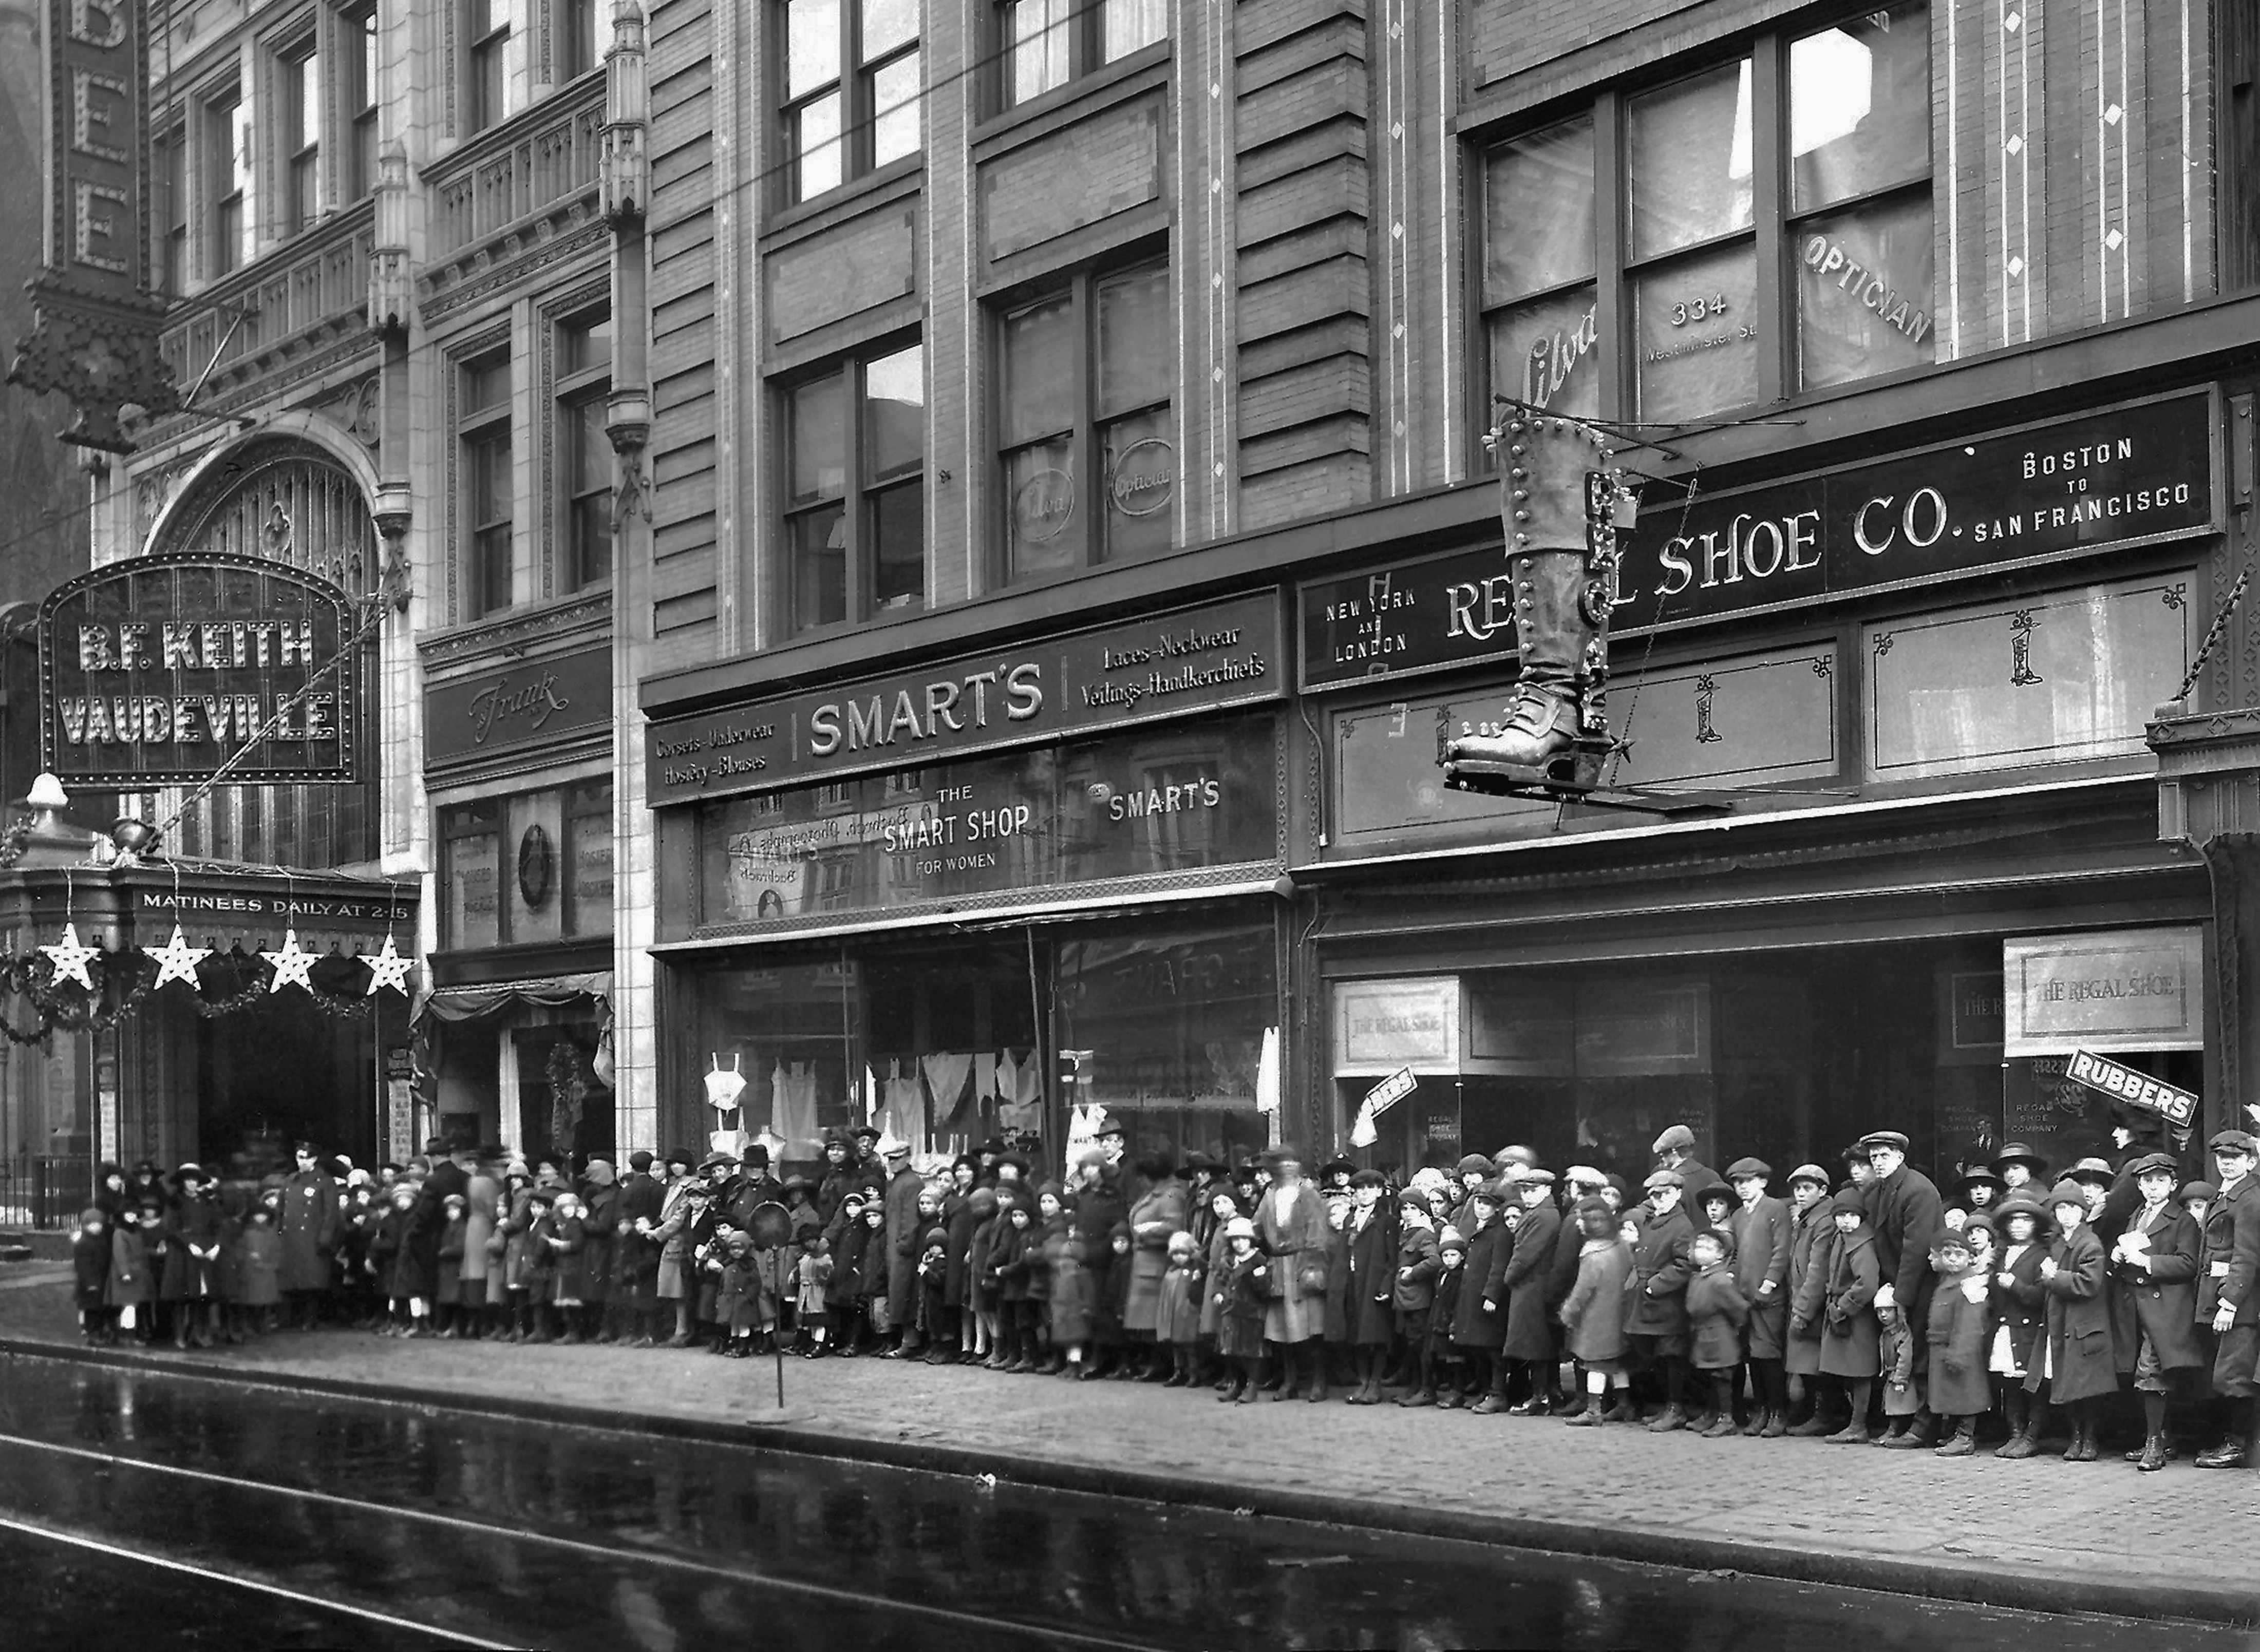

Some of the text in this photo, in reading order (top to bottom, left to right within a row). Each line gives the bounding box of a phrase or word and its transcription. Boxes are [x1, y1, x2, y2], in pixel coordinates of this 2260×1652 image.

[1670, 292, 1726, 326] 334
[1804, 235, 1931, 343] OPTICIAN
[2023, 438, 2133, 479] BOSTON
[2066, 479, 2088, 494] TO
[1974, 482, 2190, 543] SAN FRANCISCO
[1446, 486, 1964, 640] REL SHOE CO.
[1326, 588, 1416, 622] NEW YORK
[78, 619, 312, 671] B.F. KEITH
[1358, 619, 1381, 635] AND
[1334, 633, 1407, 663] LONDON
[59, 692, 335, 744] VAUDEVILLE
[468, 669, 570, 743] Frank
[810, 663, 1043, 756] SMART'S
[937, 784, 973, 803] THE
[1109, 777, 1220, 820] SMART'S
[884, 804, 1029, 852] SMART SHOP
[915, 852, 996, 876] FOR WOMEN
[143, 893, 262, 913] MATINEES
[273, 900, 333, 917] DAILY
[336, 904, 365, 918] AT
[2068, 979, 2126, 1002] REGAL
[2129, 972, 2174, 996] SHOE
[2073, 1052, 2192, 1121] RUBBERS
[2011, 1124, 2058, 1133] COMPANY
